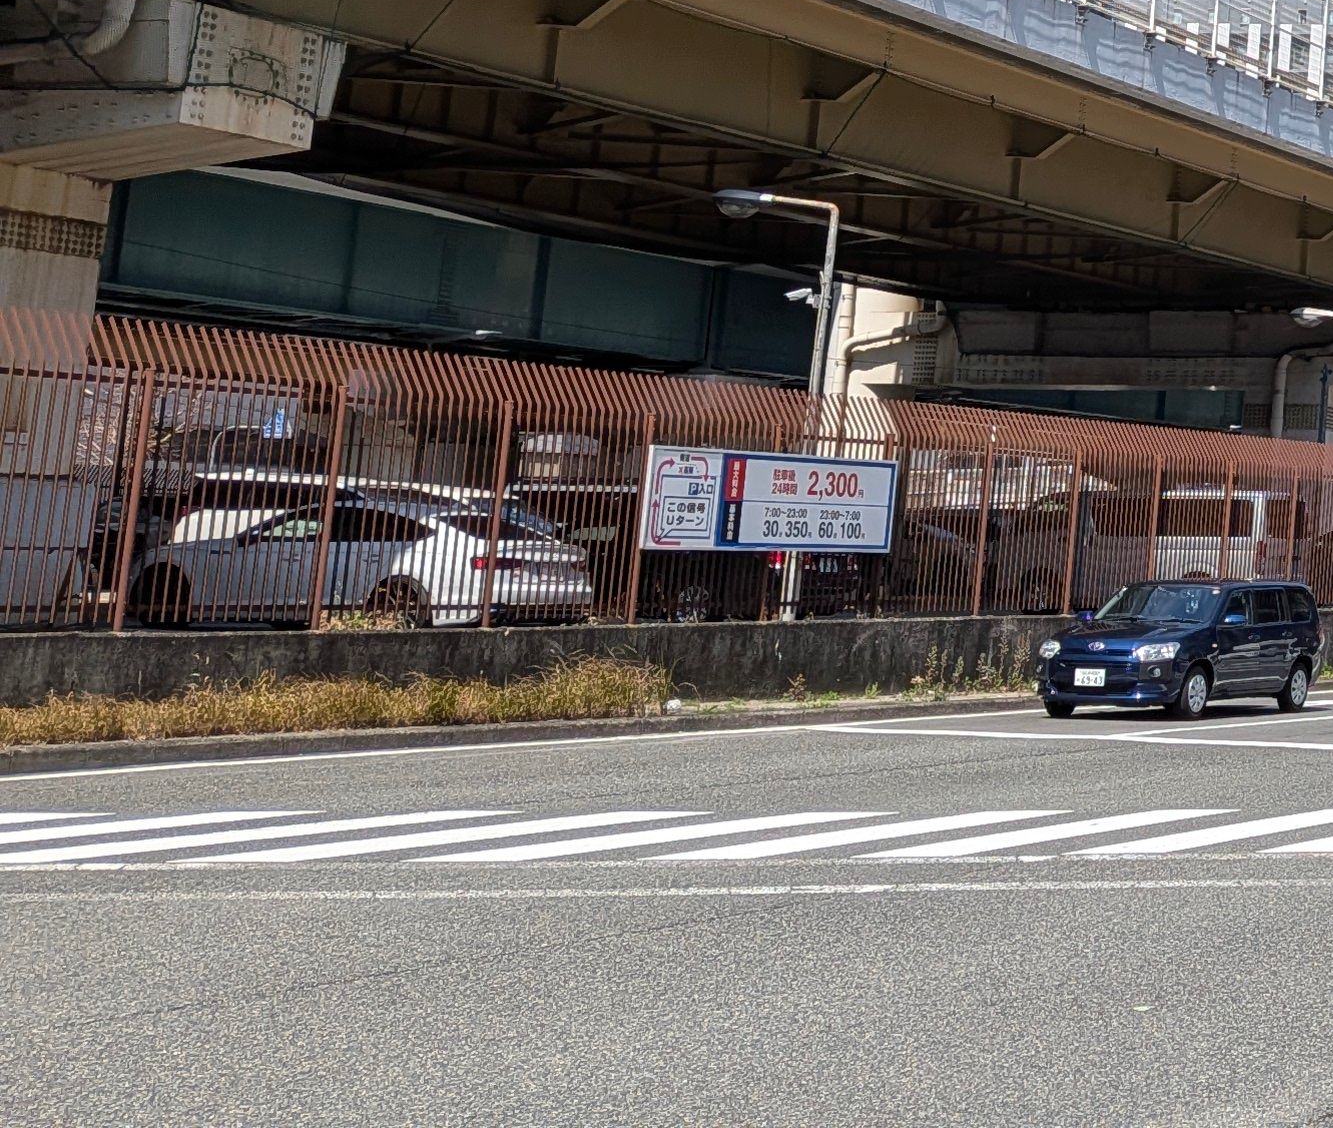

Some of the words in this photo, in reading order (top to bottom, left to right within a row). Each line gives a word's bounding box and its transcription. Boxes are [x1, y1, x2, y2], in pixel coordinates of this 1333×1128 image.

[771, 483, 798, 495] 24時間
[667, 503, 705, 513] この信号
[666, 515, 704, 526] Uターン
